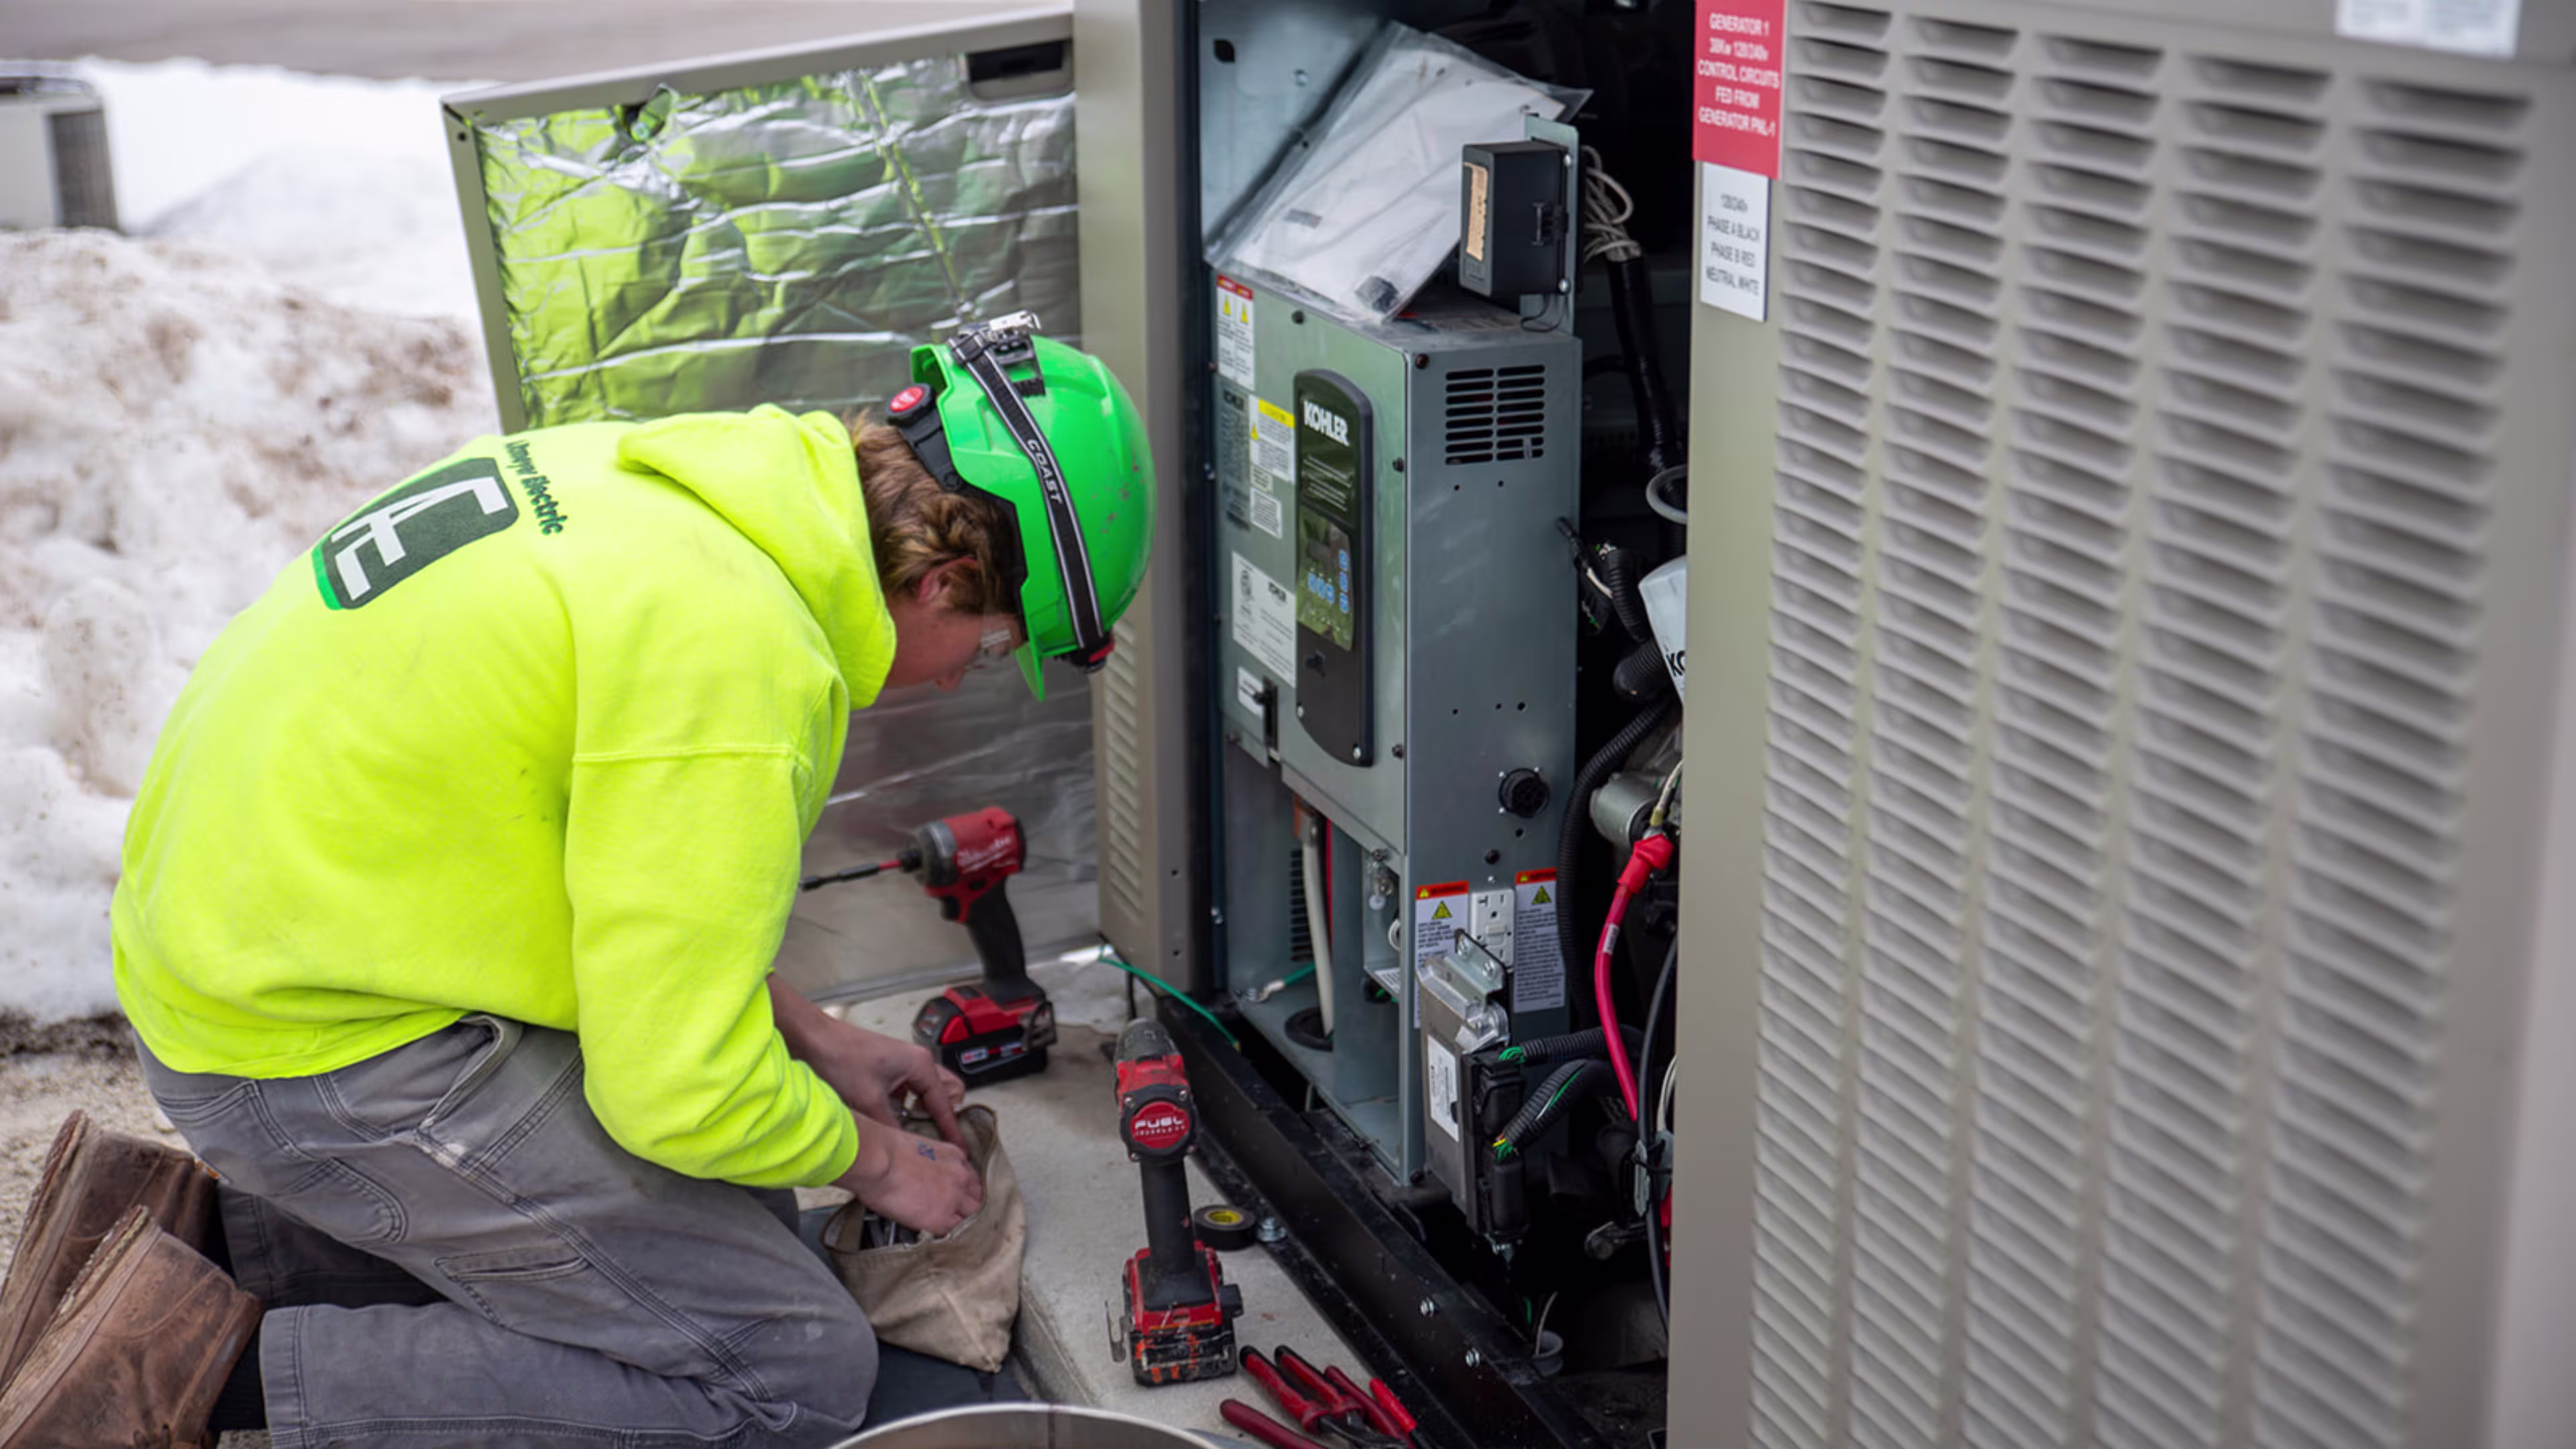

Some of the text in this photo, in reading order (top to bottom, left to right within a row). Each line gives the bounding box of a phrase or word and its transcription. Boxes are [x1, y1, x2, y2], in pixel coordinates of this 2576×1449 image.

[1709, 13, 1770, 37] GENERATOR 1
[1698, 60, 1780, 89] CONTROL CIRCUITS
[1715, 85, 1760, 109] FED FROM
[1699, 105, 1749, 130] GENERATOR
[1707, 215, 1729, 235] PHASE
[1737, 222, 1760, 242] BLACK
[1711, 241, 1733, 262] PHASE
[1741, 250, 1756, 268] RED
[1738, 276, 1760, 297] WHITE
[1303, 399, 1350, 446] KOHLER
[1027, 439, 1063, 504] COAST
[521, 475, 568, 535] Electric
[1134, 1116, 1183, 1130] FUEL
